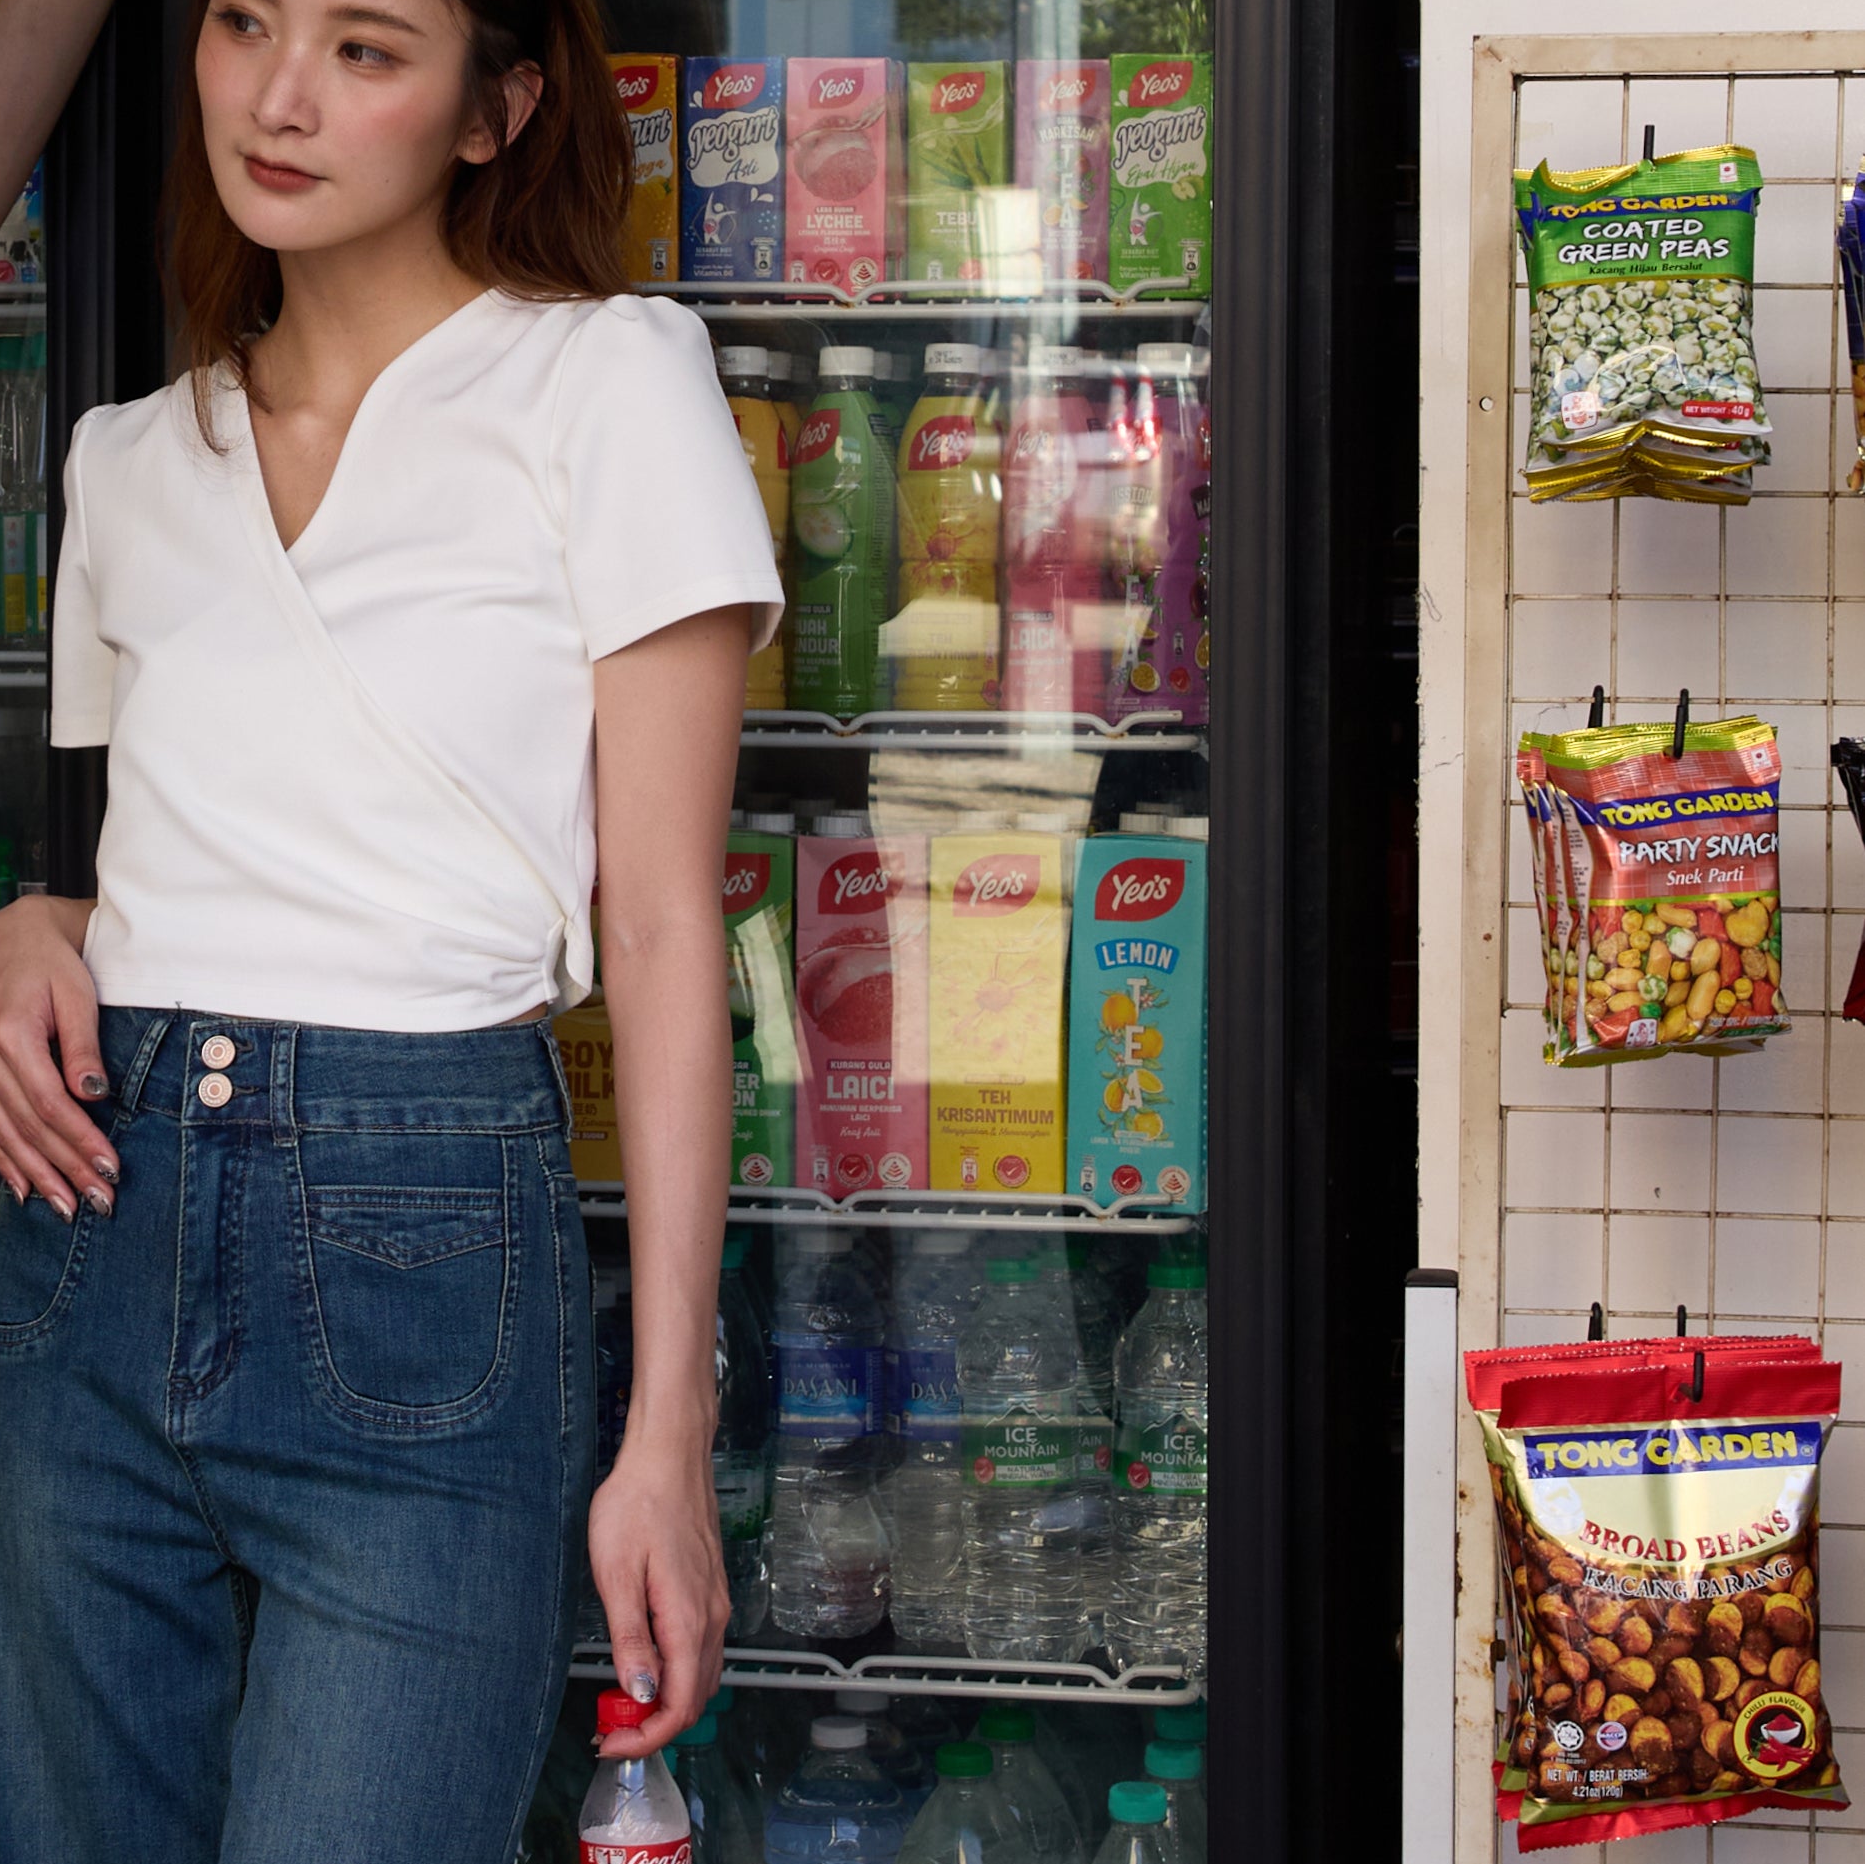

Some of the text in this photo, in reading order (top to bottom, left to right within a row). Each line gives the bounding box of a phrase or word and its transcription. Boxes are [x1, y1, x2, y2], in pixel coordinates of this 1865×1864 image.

[714, 75, 756, 102] Yeo's
[818, 77, 856, 102] Yeo's
[940, 82, 978, 108] Yeo's
[1047, 80, 1088, 104] Yeo's
[1140, 72, 1184, 101] Yeo's
[686, 105, 779, 170] yeogurt
[1112, 105, 1206, 170] yeogurt
[725, 158, 760, 181] Asli
[936, 211, 977, 226] TEBU
[1548, 194, 1729, 219] TONG GARDEN
[806, 214, 864, 229] LYCHEE
[1583, 218, 1704, 240] COATED
[1558, 238, 1730, 265] GREEN PEAS
[1589, 262, 1703, 275] Kacang Hijau Bersalut
[1685, 405, 1699, 414] NET
[1700, 405, 1726, 414] WEIGHT
[919, 428, 968, 462] Yeo's
[1599, 790, 1774, 826] TONG GARDEN
[1618, 832, 1780, 865] PARTY SNACK
[834, 867, 893, 905] Yeo's
[1666, 865, 1744, 887] Snek Parti
[968, 870, 1027, 908] Yeo's
[1111, 874, 1171, 912] Yeo's
[1101, 941, 1174, 970] LEMON
[1121, 977, 1148, 1112] TEA
[830, 1061, 891, 1070] KURANG GULA
[826, 1075, 895, 1101] LAICI
[978, 1089, 1012, 1105] TEH
[850, 1113, 871, 1121] LAICI
[936, 1106, 1054, 1125] KRISANTIMUM
[784, 1375, 858, 1399] DASANI
[1004, 1426, 1038, 1445] ICE
[1163, 1434, 1197, 1451] ICE
[984, 1442, 1060, 1461] MOUNTAIN
[1536, 1430, 1798, 1471] TONG GARDEN
[1578, 1509, 1791, 1563] BROAD BEANS
[1582, 1557, 1793, 1601] KACANG PARANG
[1743, 1695, 1807, 1720] CHILLI FLAVOUR
[1546, 1768, 1563, 1783] NET
[1565, 1769, 1580, 1783] WT.
[1588, 1768, 1616, 1783] BERAT
[587, 1845, 595, 1863] ME
